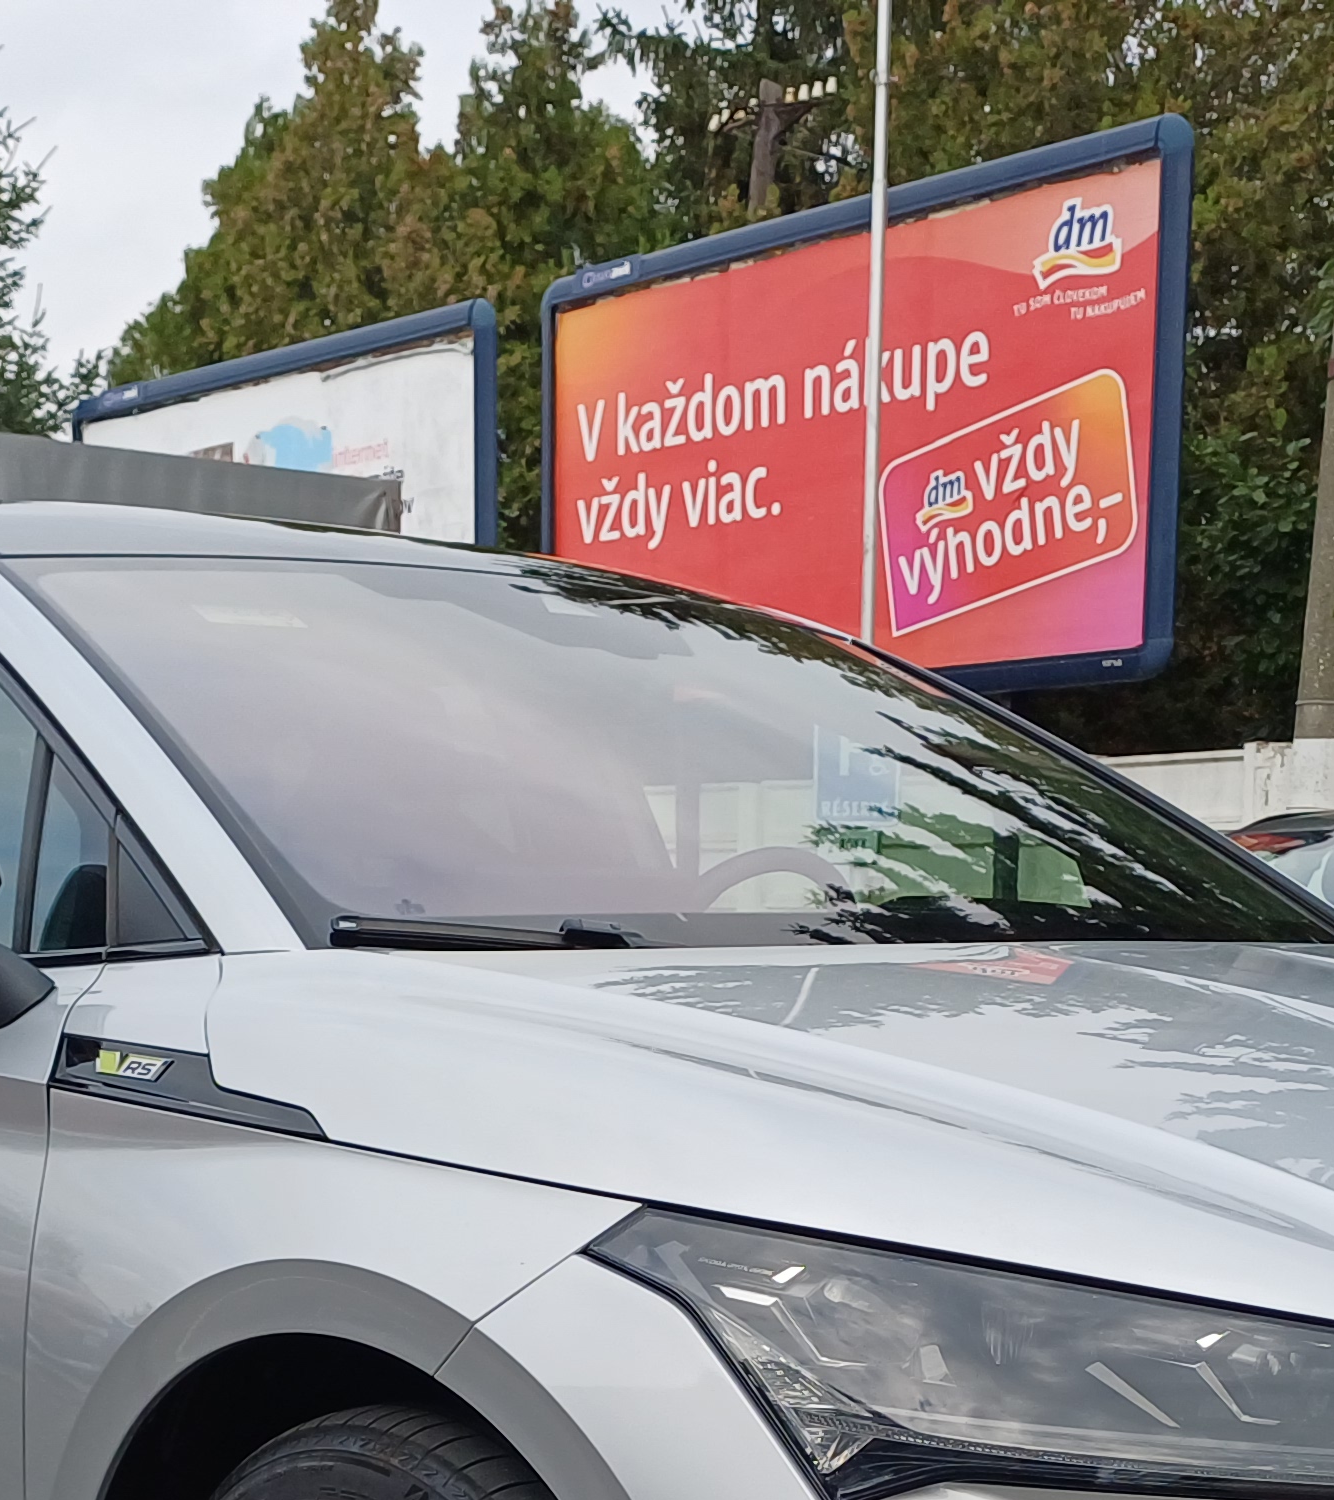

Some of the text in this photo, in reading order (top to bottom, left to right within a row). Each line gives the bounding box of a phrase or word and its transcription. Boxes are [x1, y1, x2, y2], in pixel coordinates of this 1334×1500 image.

[576, 398, 605, 462] V
[616, 372, 786, 456] každom
[576, 459, 781, 550] vždy viac.
[927, 418, 1080, 508] dm vždy
